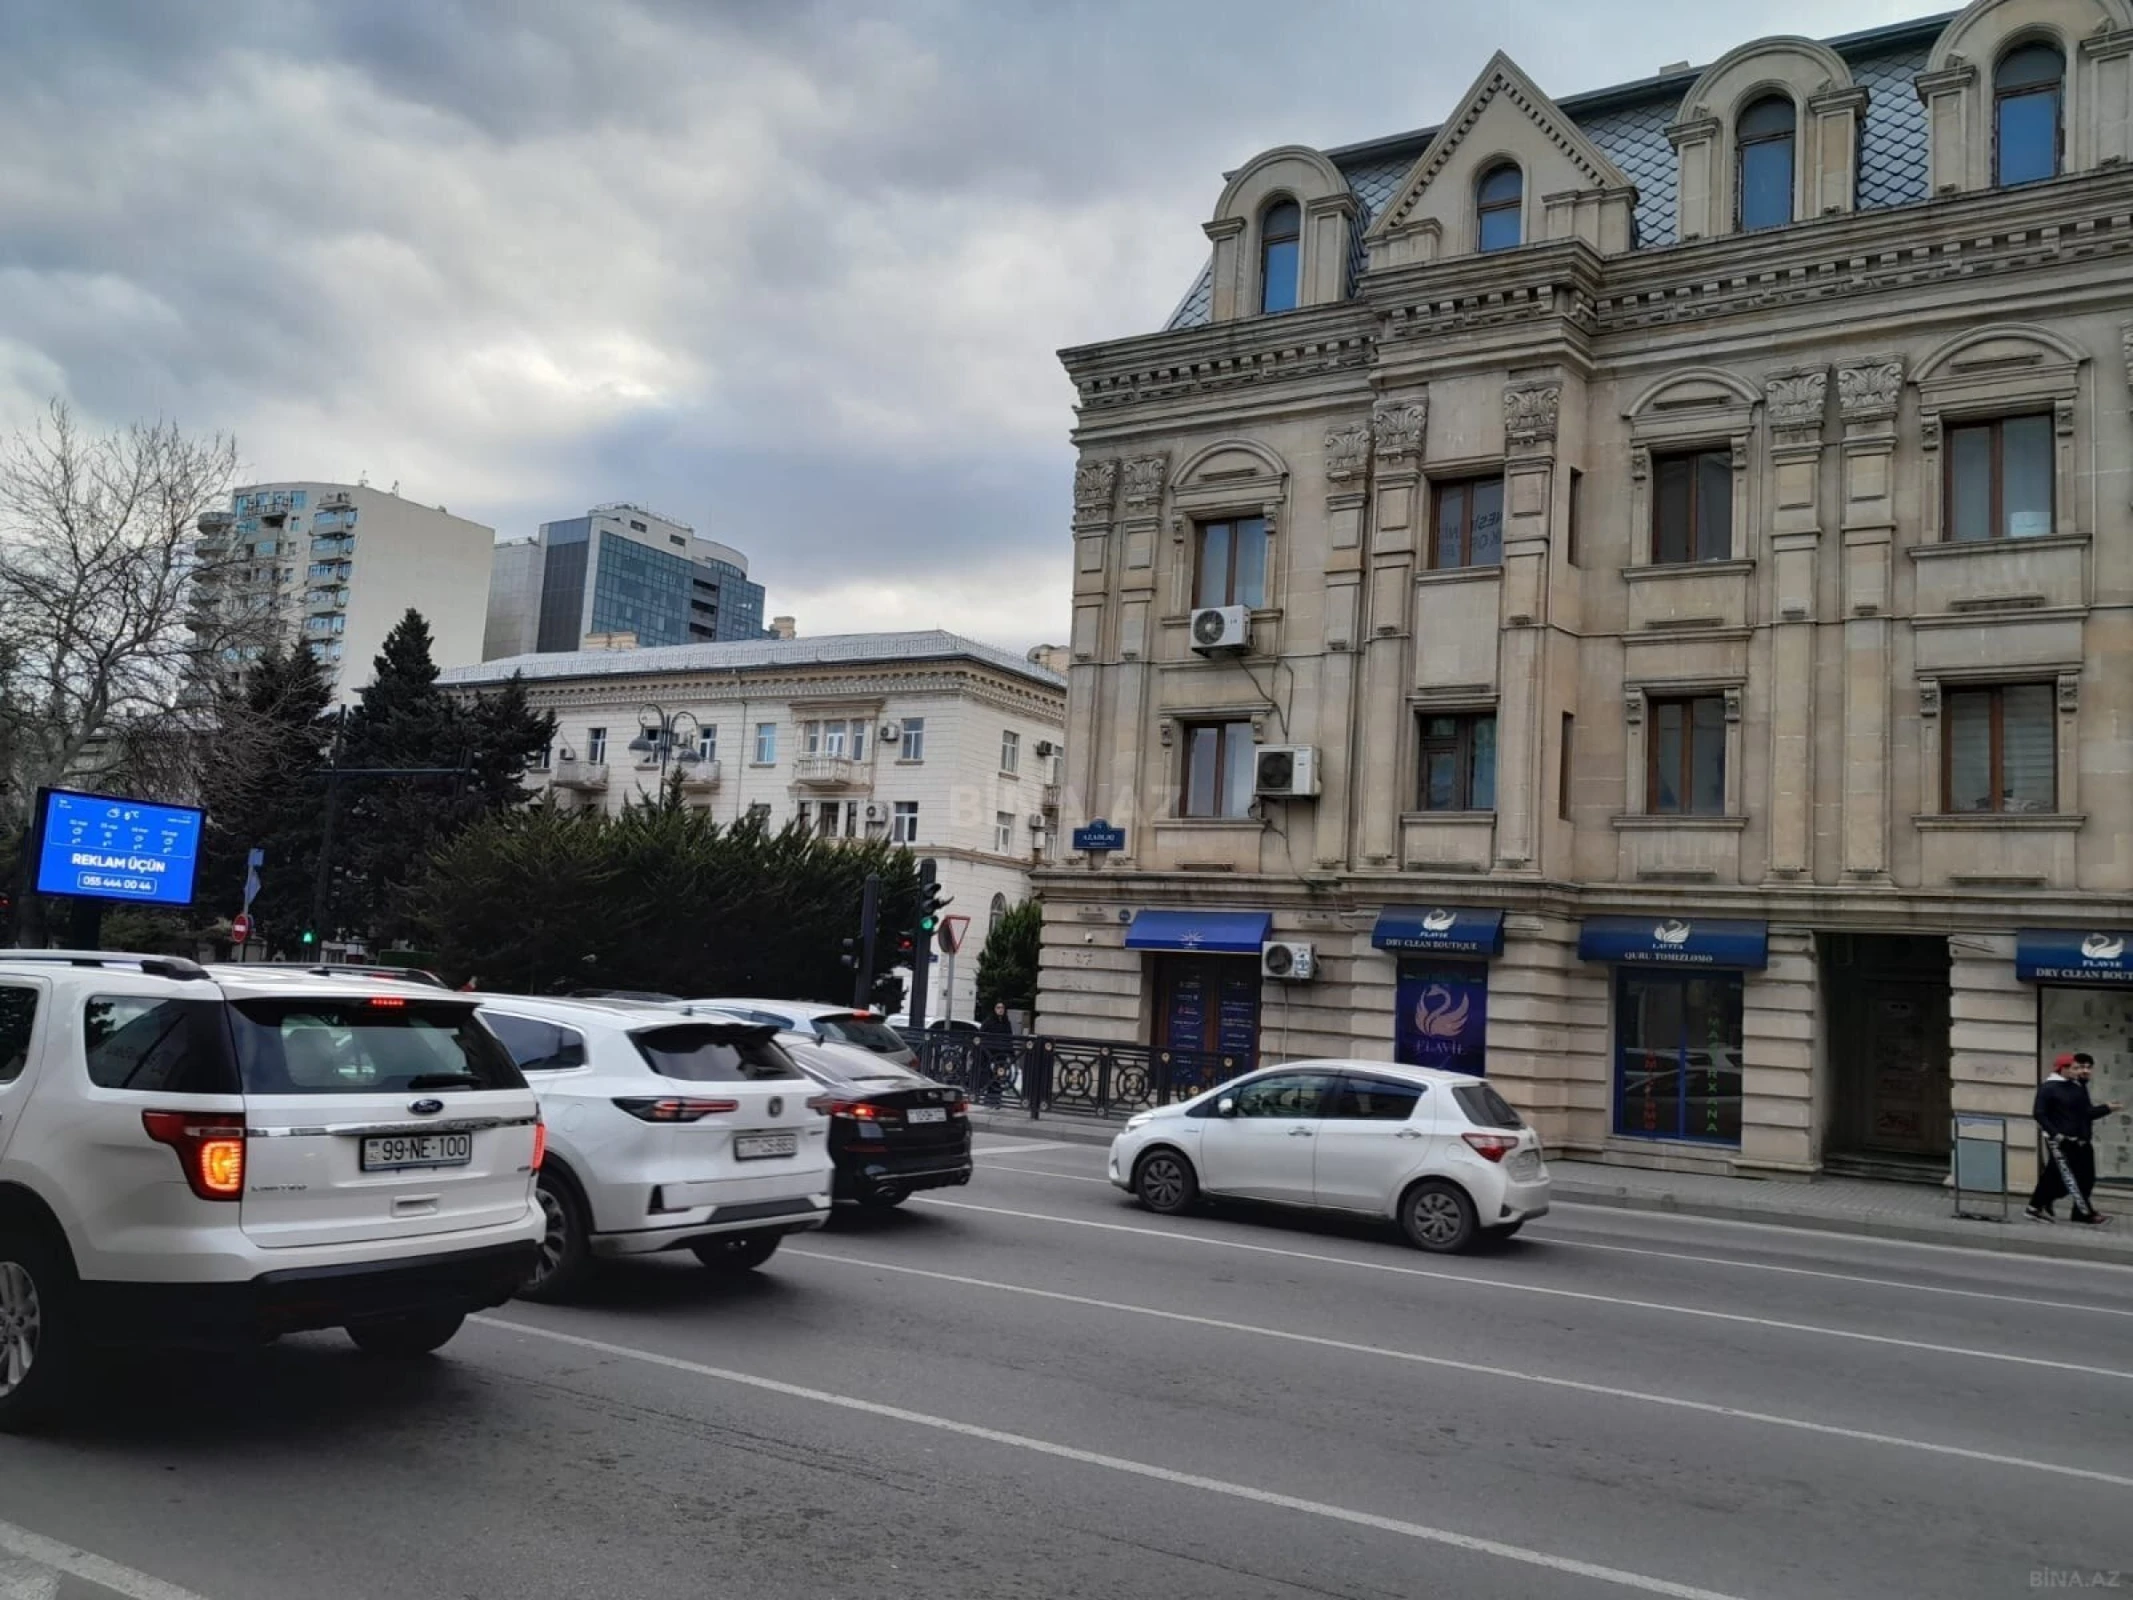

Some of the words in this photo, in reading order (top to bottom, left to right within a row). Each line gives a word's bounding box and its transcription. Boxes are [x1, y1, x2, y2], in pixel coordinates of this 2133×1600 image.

[72, 853, 126, 870] REKLAM
[128, 856, 166, 874] ÜÇÜN
[82, 876, 102, 886] 055
[103, 878, 122, 888] 444
[124, 879, 138, 889] 00
[1386, 938, 1402, 947] DRY
[1404, 940, 1432, 949] CLEAN
[1433, 941, 1478, 951] BOUTIQUE
[2036, 967, 2059, 977] DRY
[2061, 969, 2101, 979] CLEAN
